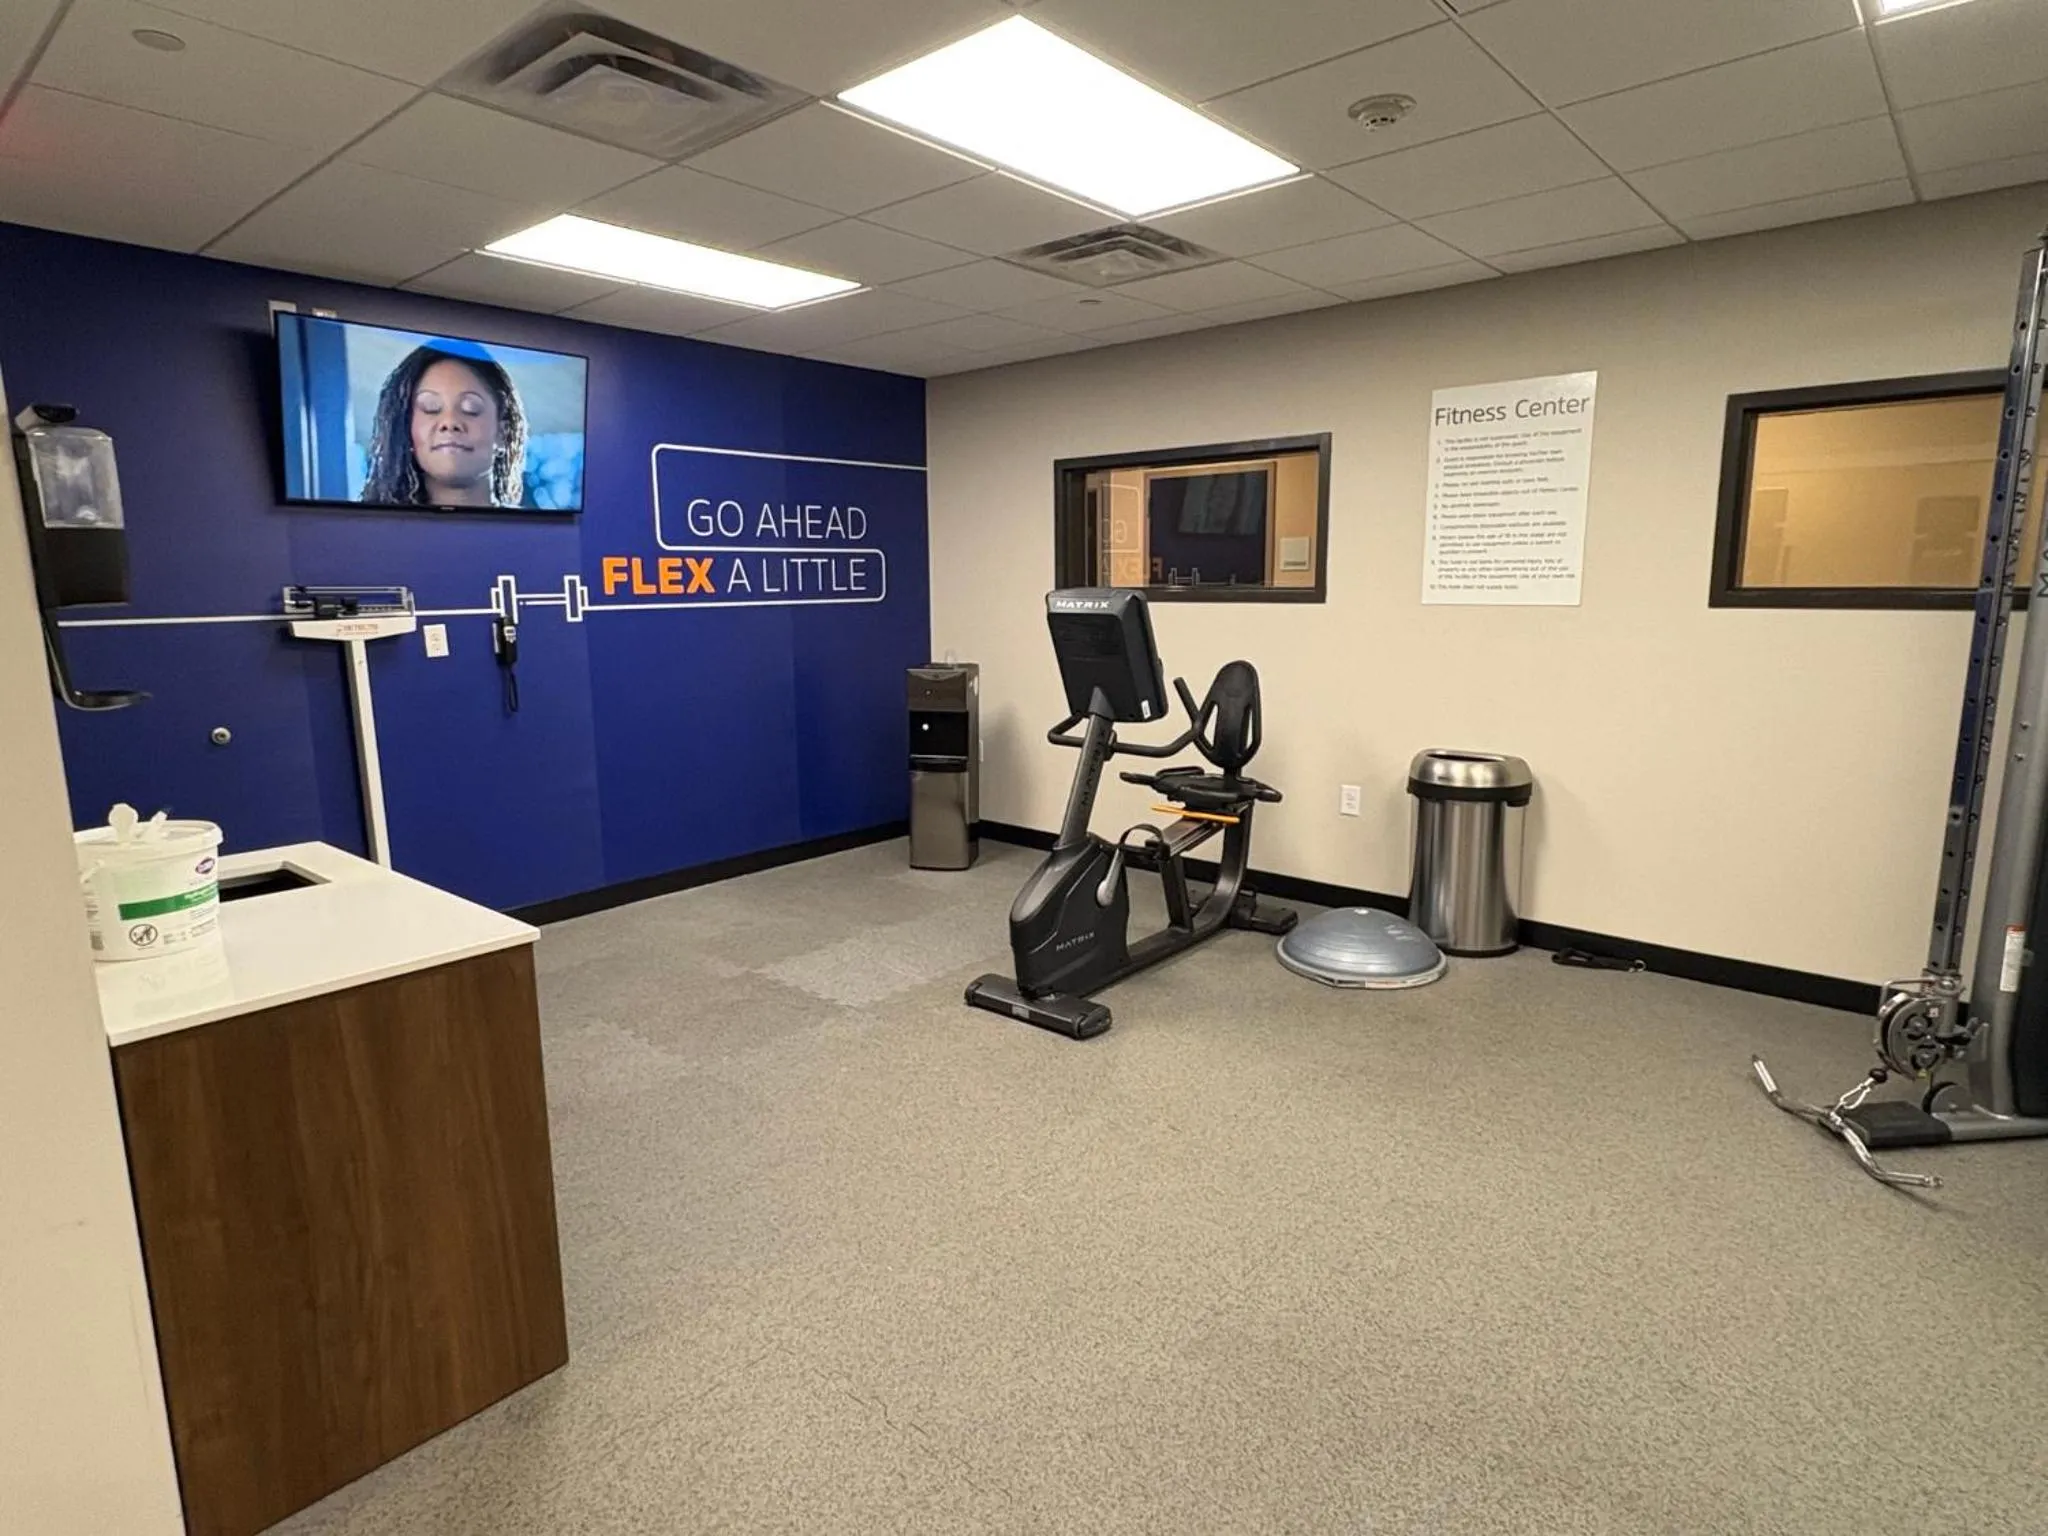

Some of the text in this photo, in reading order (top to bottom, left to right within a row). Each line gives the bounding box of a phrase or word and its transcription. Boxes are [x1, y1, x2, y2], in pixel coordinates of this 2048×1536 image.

[1434, 395, 1591, 427] Fitness Center
[687, 498, 868, 541] GO AHEAD
[601, 556, 868, 596] FLEX A LITTLE
[1055, 600, 1110, 609] MATRIX
[1055, 931, 1095, 952] MATRIX
